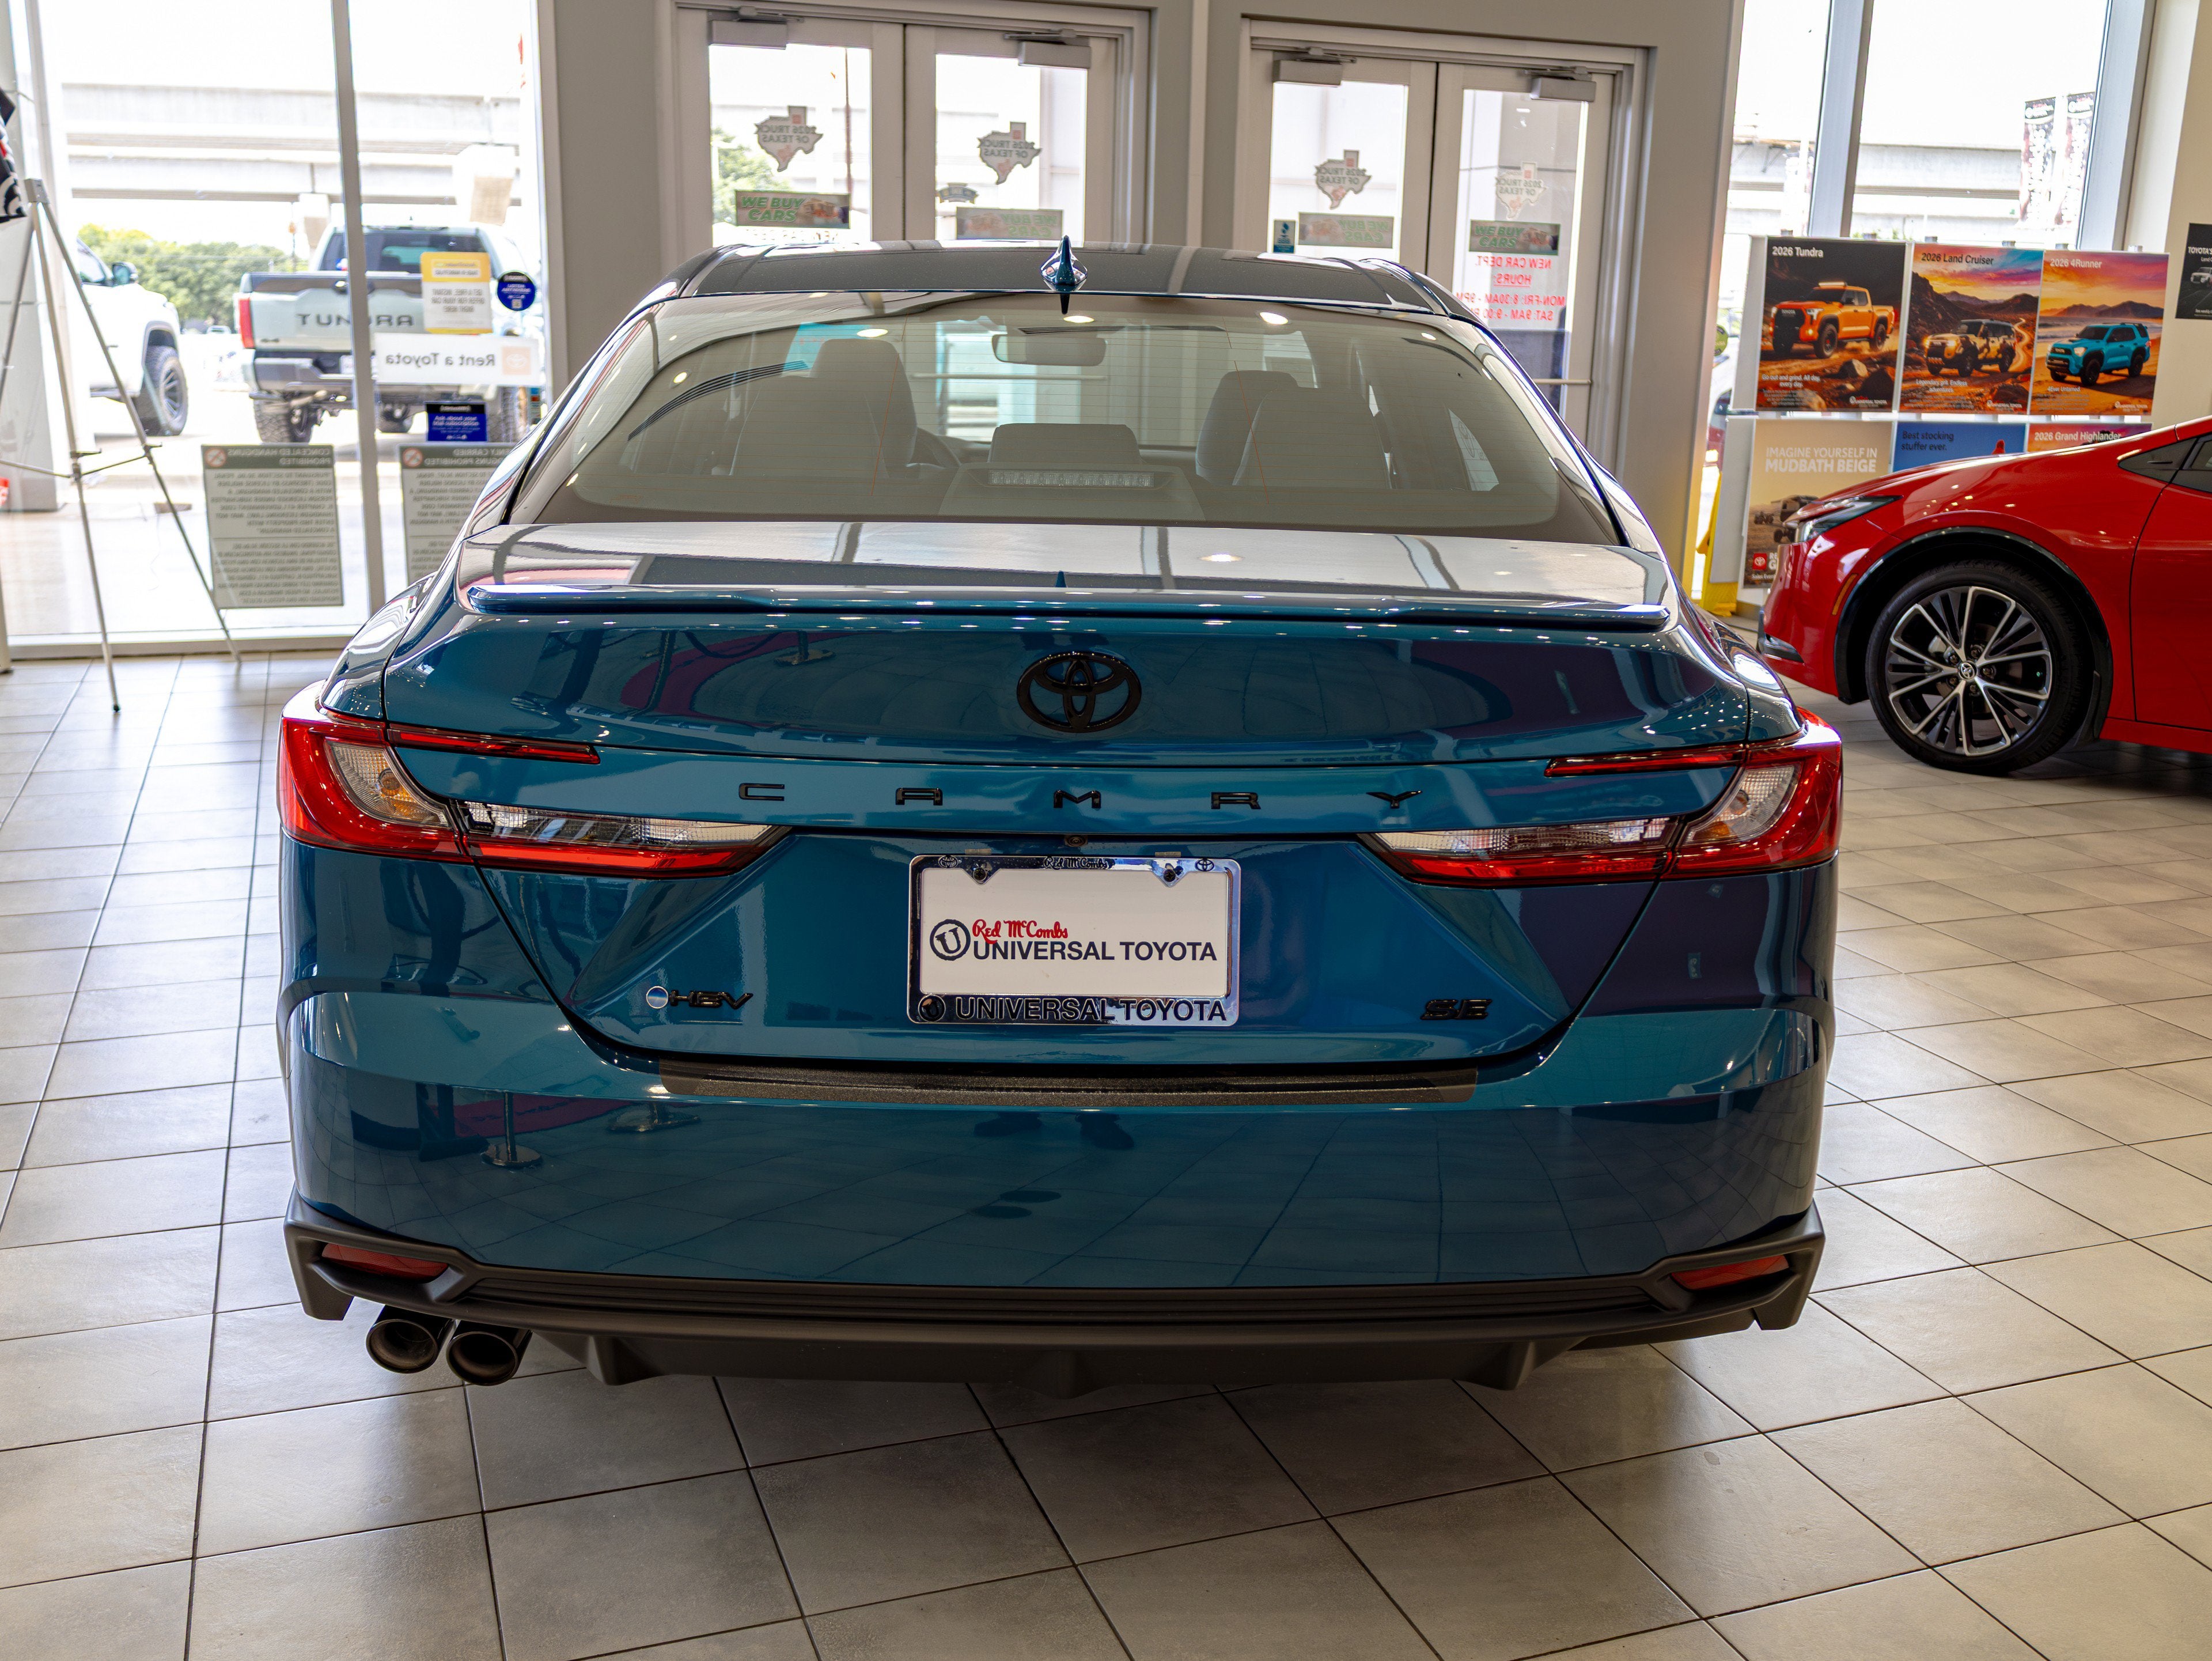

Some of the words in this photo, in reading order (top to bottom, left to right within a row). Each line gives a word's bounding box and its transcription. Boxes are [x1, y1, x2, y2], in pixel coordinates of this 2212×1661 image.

[741, 196, 768, 207] WE
[771, 198, 805, 209] BUY
[748, 209, 797, 222] CARS
[1475, 225, 1496, 235] WE
[1497, 226, 1525, 236] BUY
[1479, 236, 1516, 248] CARS
[1772, 246, 1793, 256] 2026
[1795, 247, 1824, 258] Tundra
[1921, 252, 1941, 261] 2026
[1943, 253, 1963, 263] Land
[1965, 255, 1994, 265] Cruiser
[2050, 259, 2069, 267] 2026
[2070, 259, 2103, 269] 4Runner
[297, 313, 413, 326] TUNRA
[1902, 431, 1921, 440] Best
[1922, 432, 1954, 442] stocking
[2035, 432, 2054, 441] 2026
[2055, 432, 2078, 440] Grand
[2080, 431, 2122, 443] Highlander
[1766, 448, 1810, 458] IMAGINE
[1814, 448, 1865, 458] YOURSELF
[1867, 448, 1877, 458] IN
[1901, 442, 1927, 451] stuffer
[1929, 443, 1948, 451] ever.
[1765, 459, 1834, 472] MUDBATH
[1837, 459, 1876, 472] BEIGE
[738, 781, 1423, 810] CAMRY
[1044, 856, 1063, 870] Red
[1065, 857, 1109, 869] McCombs
[972, 918, 1001, 944] Red
[1003, 920, 1069, 939] McCombs
[974, 941, 1115, 961] UNIVERSAL
[1119, 941, 1218, 961] TOYOTA
[670, 989, 753, 1010] HEV
[956, 997, 1115, 1020] UNIVERSAL
[1119, 998, 1228, 1021] TOYOTA
[1420, 999, 1493, 1020] SE
